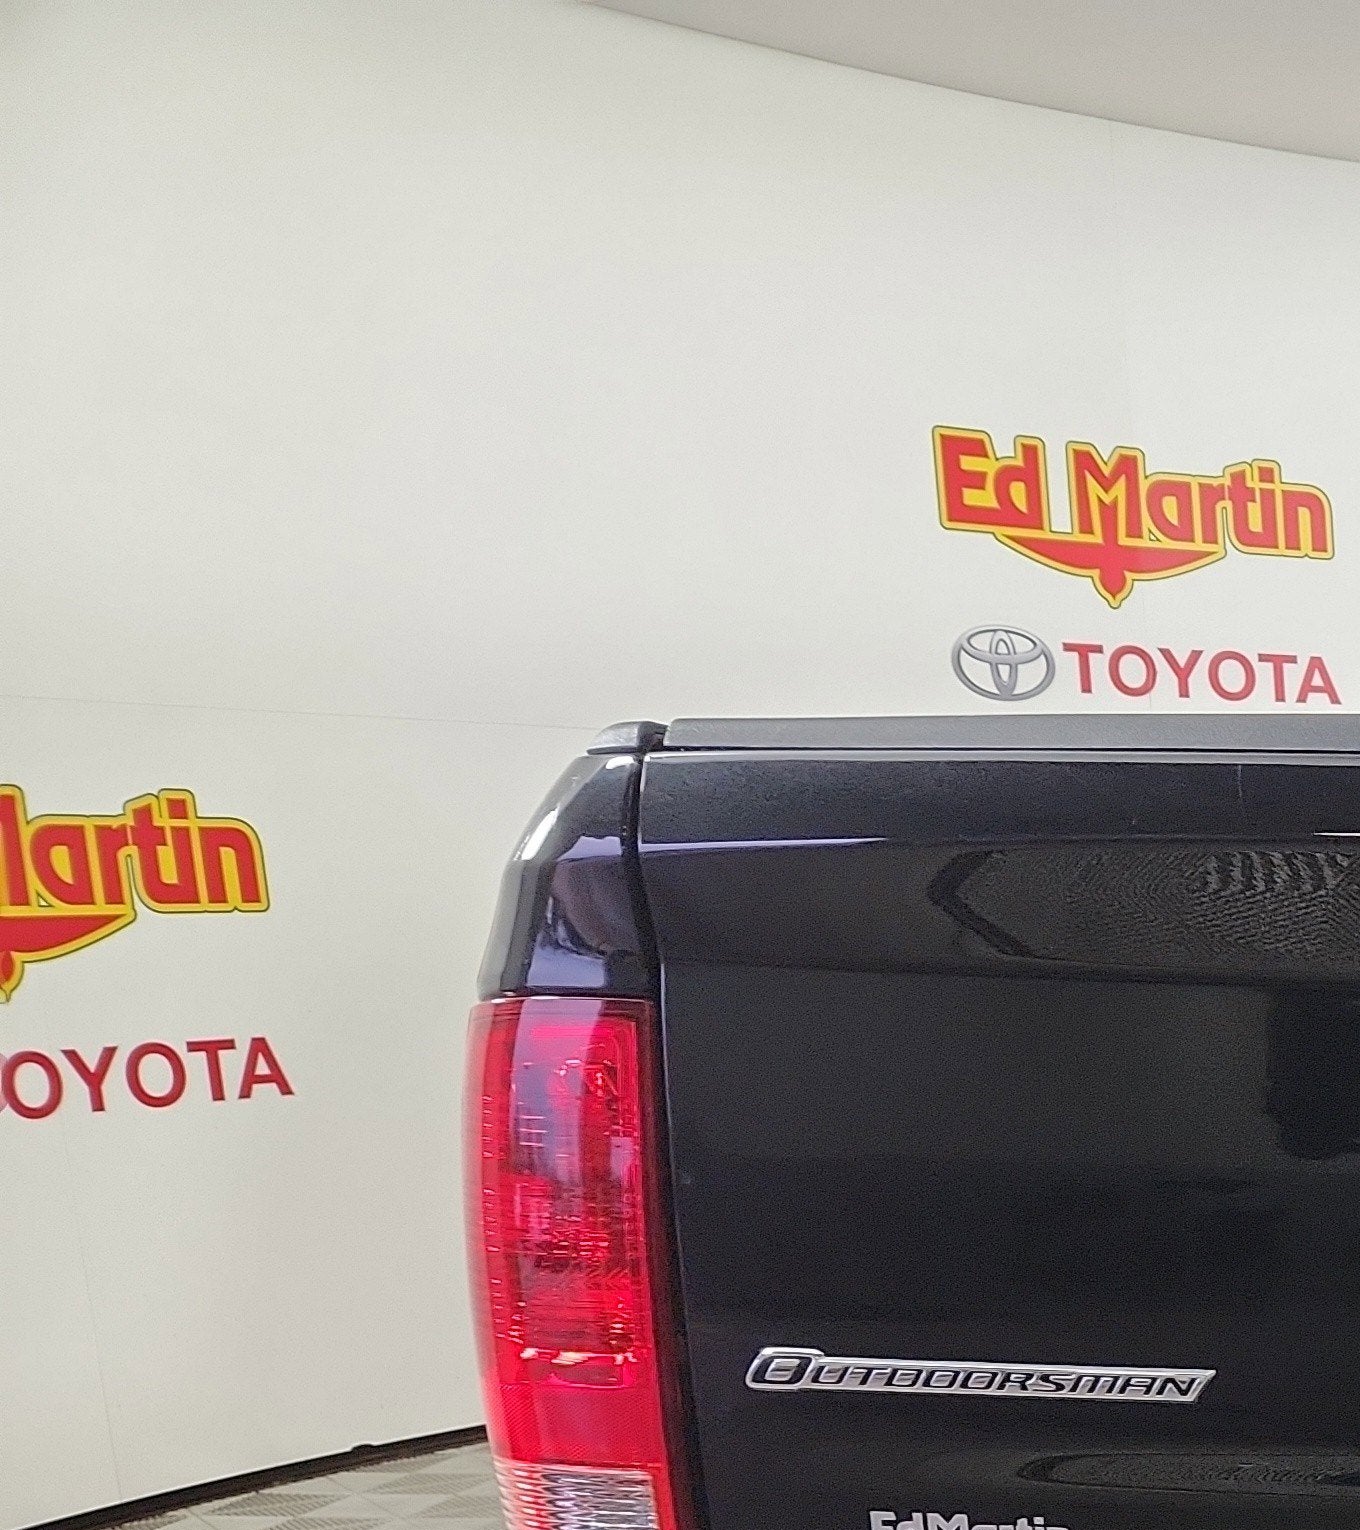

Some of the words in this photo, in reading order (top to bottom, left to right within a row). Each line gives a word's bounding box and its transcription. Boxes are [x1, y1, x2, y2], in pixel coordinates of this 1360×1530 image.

[934, 427, 1048, 532] Ed
[1068, 443, 1333, 558] Martin
[1062, 642, 1342, 705] TOYOTA
[0, 1037, 295, 1120] OYOTA
